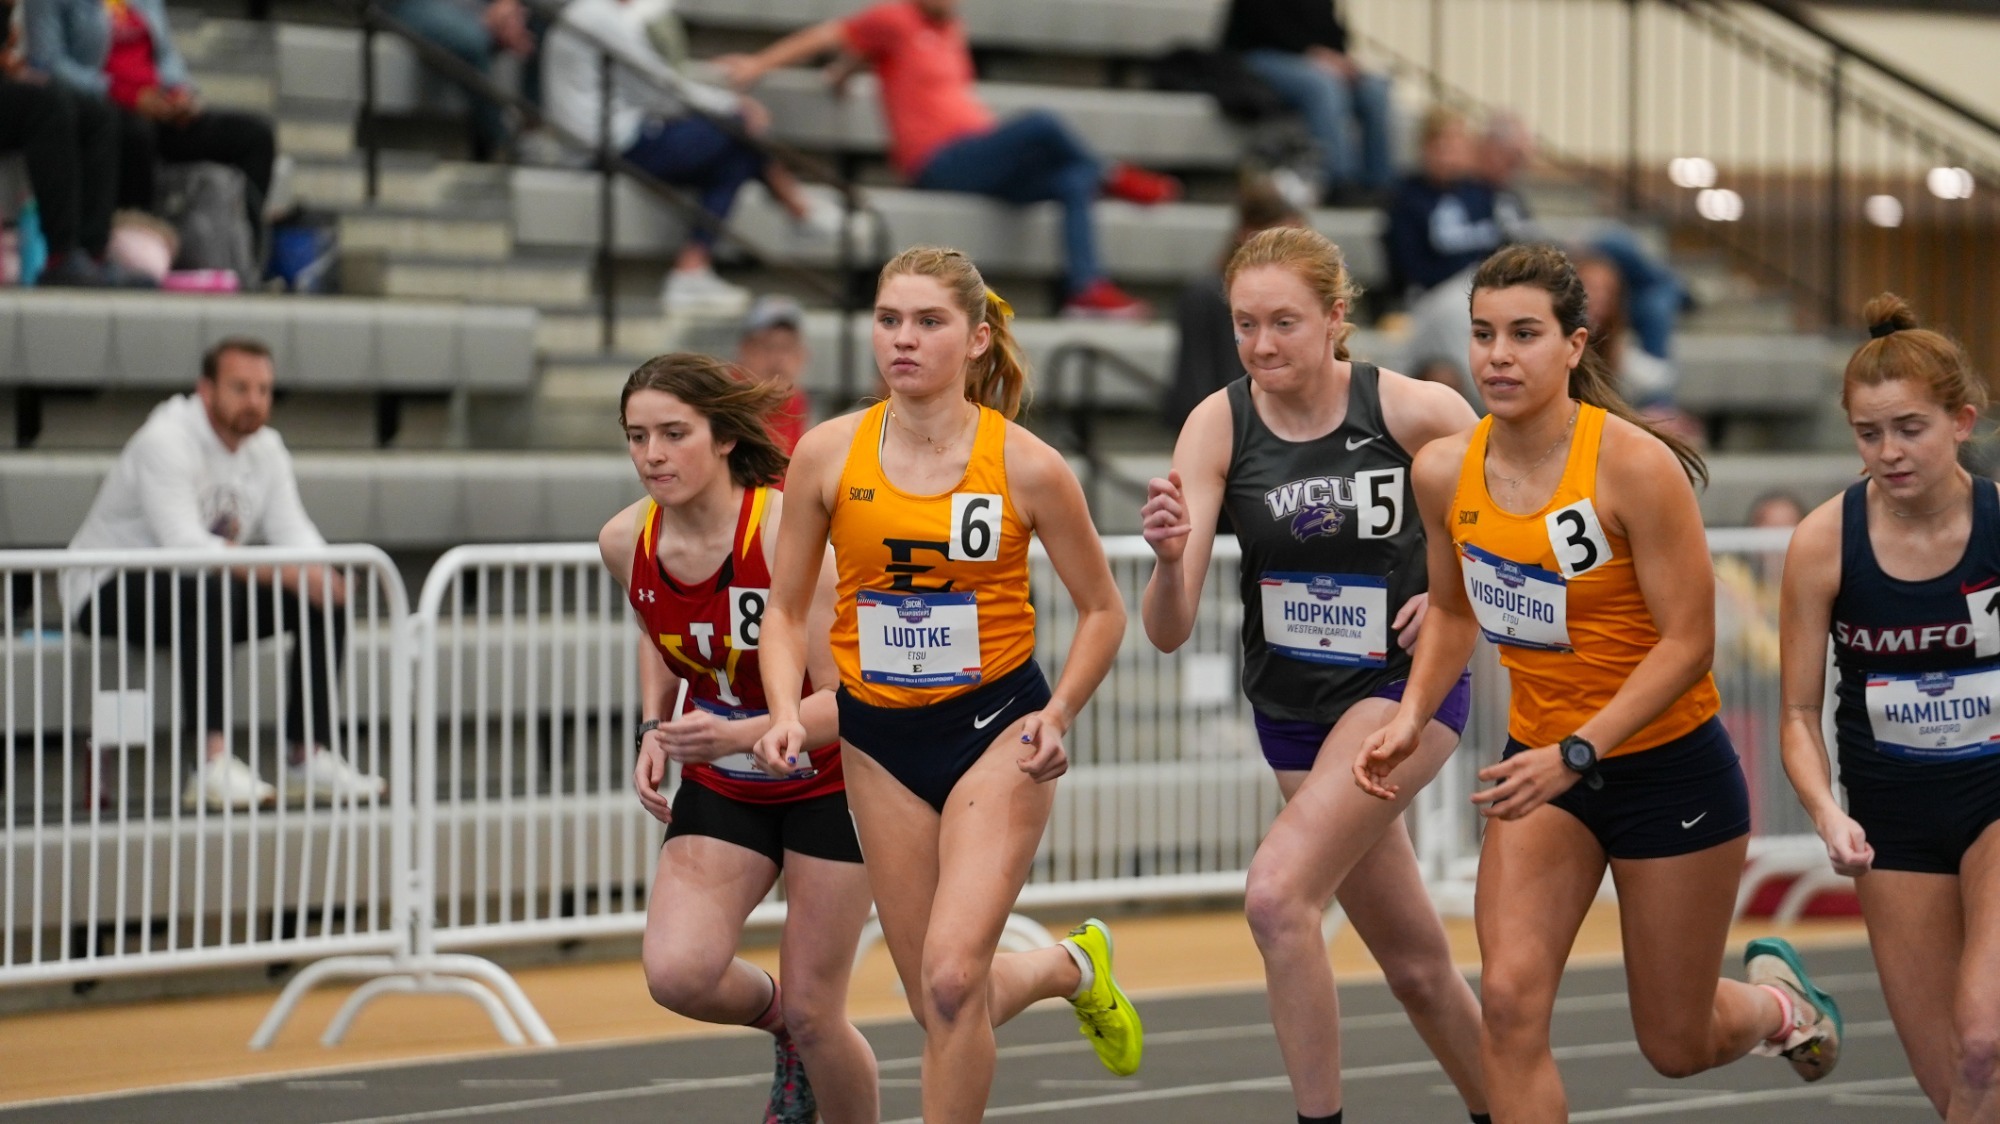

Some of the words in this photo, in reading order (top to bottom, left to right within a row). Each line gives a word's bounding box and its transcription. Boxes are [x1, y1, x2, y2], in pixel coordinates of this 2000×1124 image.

[1264, 476, 1358, 521] WCU
[1370, 474, 1396, 536] 5
[961, 498, 991, 558] 6
[1556, 509, 1598, 573] 3
[1284, 600, 1367, 628] HOPKINS
[1470, 577, 1554, 624] VISGUEIRO
[738, 591, 765, 646] 8
[1286, 623, 1323, 636] WESTERN
[1324, 627, 1362, 639] CAROLINA
[1502, 612, 1519, 626] ETSU
[883, 625, 951, 648] LUDTKE
[1835, 620, 1975, 654] SAMFO
[907, 651, 926, 660] ETSU
[1885, 696, 1991, 724] HAMILTON
[1919, 723, 1961, 735] SAMFORD
